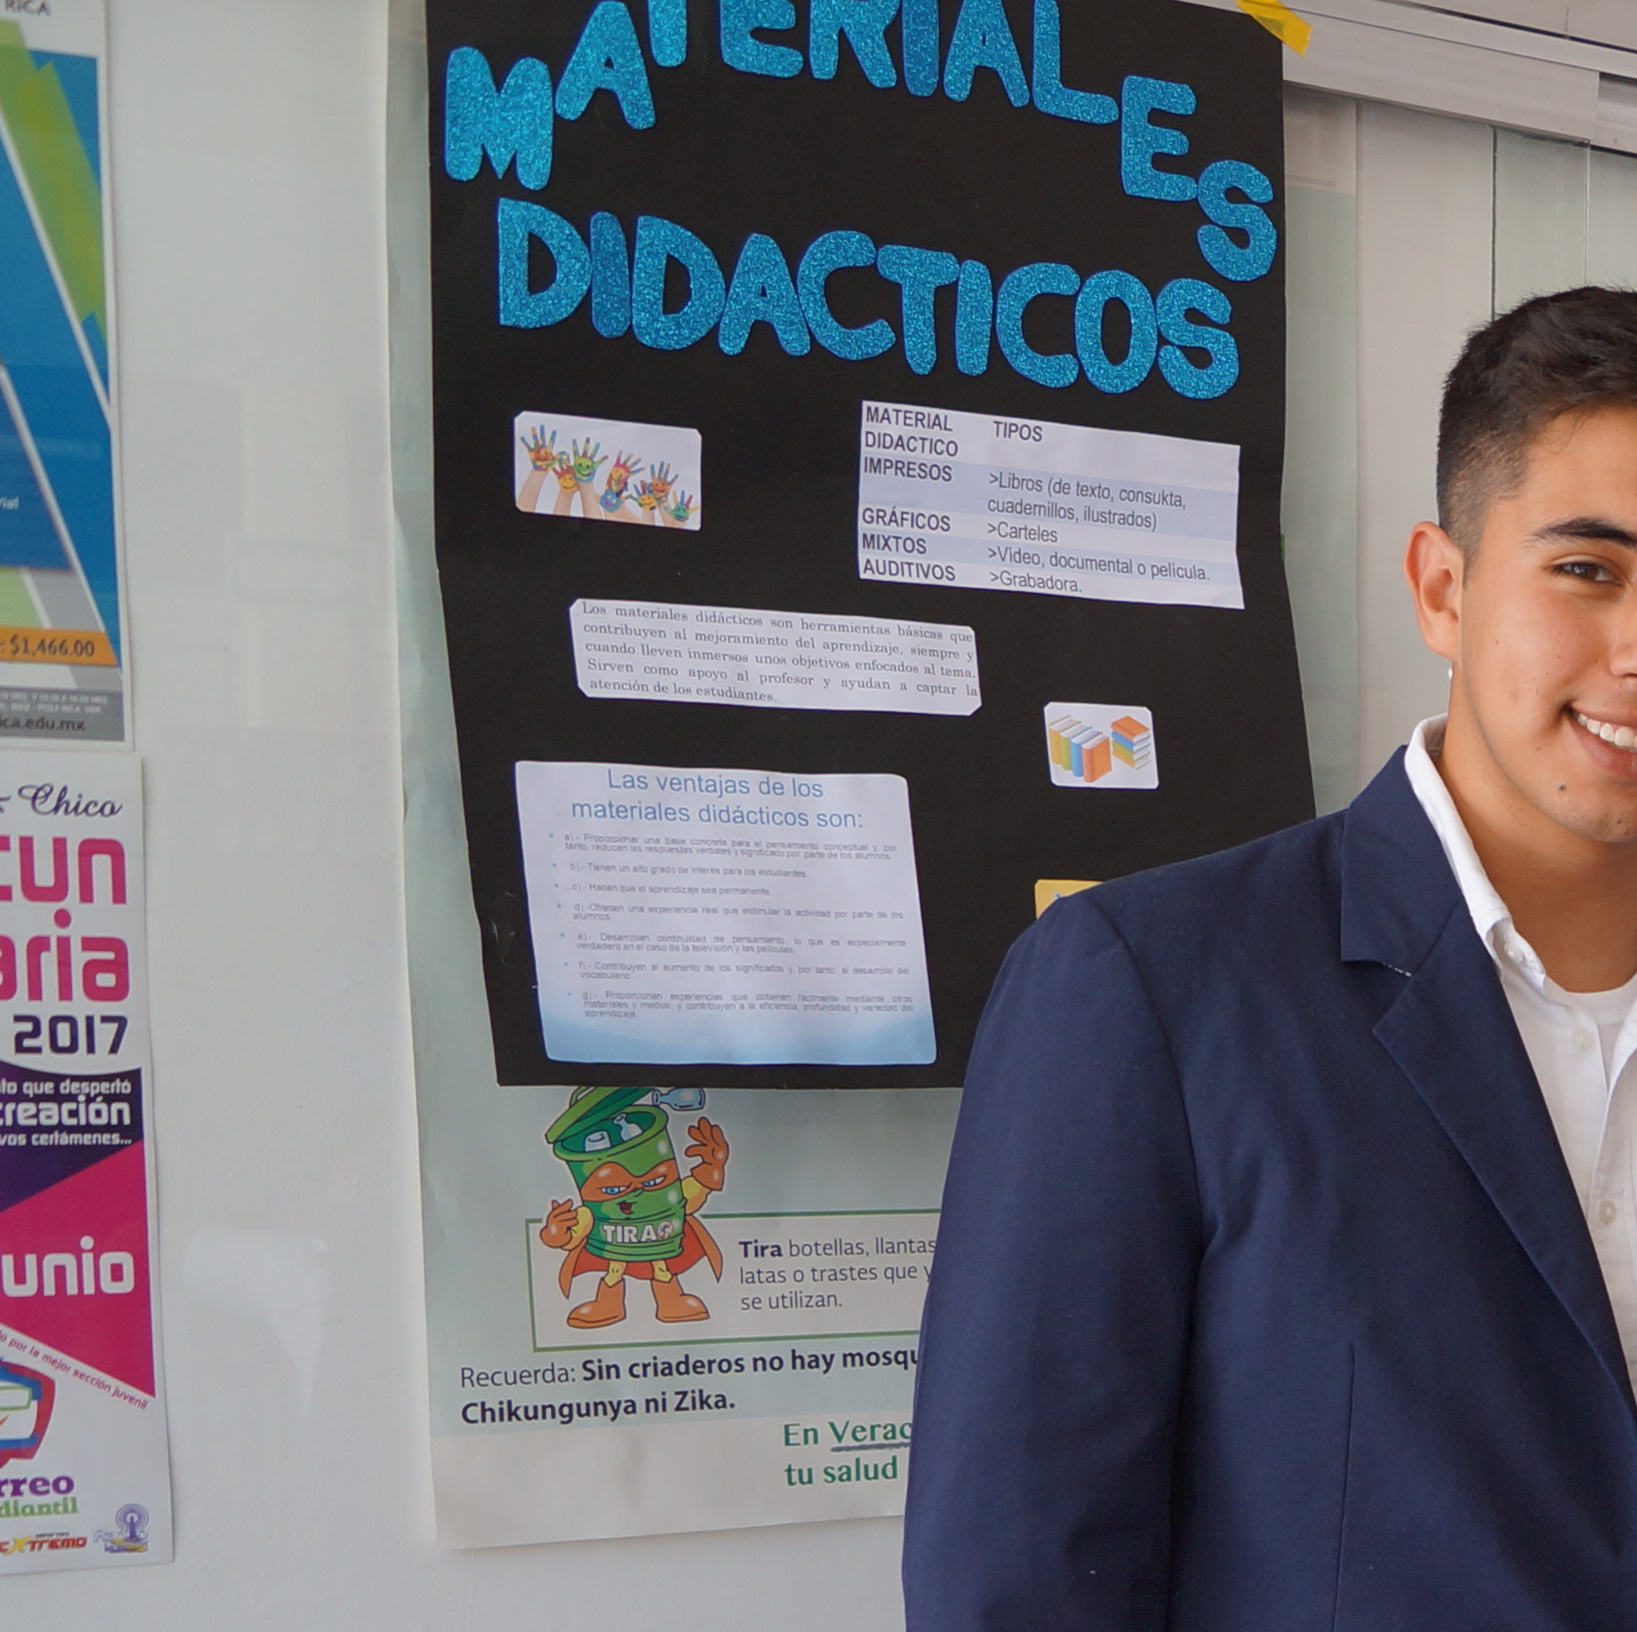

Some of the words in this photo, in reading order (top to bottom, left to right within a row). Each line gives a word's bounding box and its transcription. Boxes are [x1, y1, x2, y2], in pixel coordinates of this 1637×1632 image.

[498, 197, 1240, 399] DIDACTICOS
[865, 405, 954, 432] MATERIAL
[993, 420, 1044, 442] TIPOS
[865, 431, 958, 458] DIDACTICO
[863, 456, 952, 482] IMPRESOS
[1048, 476, 1072, 498] (de
[1075, 481, 1115, 503] texto,
[862, 505, 952, 533] GRÁFICOS
[987, 499, 1079, 522] cuadernillos,
[1083, 505, 1158, 532] ilustrados)
[862, 533, 927, 555] MIXTOS
[863, 558, 956, 581] AUDITIVOS
[1049, 551, 1133, 575] documental
[1137, 563, 1147, 576] o
[582, 601, 607, 615] Los
[615, 605, 688, 621] materiales
[695, 610, 763, 626] didácticos
[770, 618, 793, 629] son
[800, 618, 890, 636] herramientas
[897, 624, 943, 640] básicas
[950, 632, 973, 644] que
[583, 623, 667, 639] contribuyen
[674, 628, 687, 640] al
[694, 631, 789, 647] mejoramiento
[795, 636, 815, 649] del
[823, 640, 903, 656] aprendizaje,
[910, 645, 960, 660] siempre
[585, 641, 635, 655] cuando
[641, 644, 682, 659] lleven
[687, 648, 749, 663] inmersos
[755, 655, 786, 665] unos
[791, 653, 850, 669] objetivos
[855, 659, 919, 674] enfocados
[924, 663, 935, 676] al
[587, 658, 634, 673] Sirven
[643, 665, 678, 676] como
[688, 668, 728, 681] apoyo
[737, 669, 749, 682] al
[760, 671, 814, 686] profesor
[841, 677, 890, 691] ayudan
[916, 682, 957, 696] captar
[966, 684, 978, 697] la
[590, 678, 649, 693] atención
[653, 681, 669, 693] de
[674, 682, 692, 695] los
[696, 685, 778, 702] estudiantes.
[608, 769, 648, 791] Las
[656, 772, 750, 798] ventajas
[758, 776, 785, 797] de
[792, 777, 824, 798] los
[18, 783, 123, 818] Chico
[572, 800, 690, 823] materiales
[699, 804, 809, 827] didácticos
[816, 809, 863, 828] son:
[12, 1014, 129, 1055] 2017
[22, 1081, 55, 1098] que
[60, 1078, 132, 1098] despertó
[0, 1094, 131, 1127] reación
[739, 1240, 783, 1259] Tira
[788, 1237, 870, 1259] botellas,
[875, 1236, 936, 1255] llantas
[740, 1265, 786, 1285] latas
[793, 1270, 805, 1284] o
[810, 1264, 878, 1284] trastes
[883, 1264, 918, 1287] que
[741, 1294, 761, 1310] se
[767, 1291, 843, 1310] utilizan.
[461, 1363, 576, 1388] Recuerda:
[582, 1360, 620, 1382] Sin
[628, 1353, 745, 1379] criaderos
[752, 1355, 784, 1373] no
[791, 1348, 835, 1374] hay
[461, 1398, 637, 1425] Chikungunya
[644, 1393, 668, 1414] ni
[674, 1390, 736, 1412] Zika.
[783, 1424, 819, 1446] En
[784, 1463, 813, 1486] tu
[823, 1455, 899, 1484] salud
